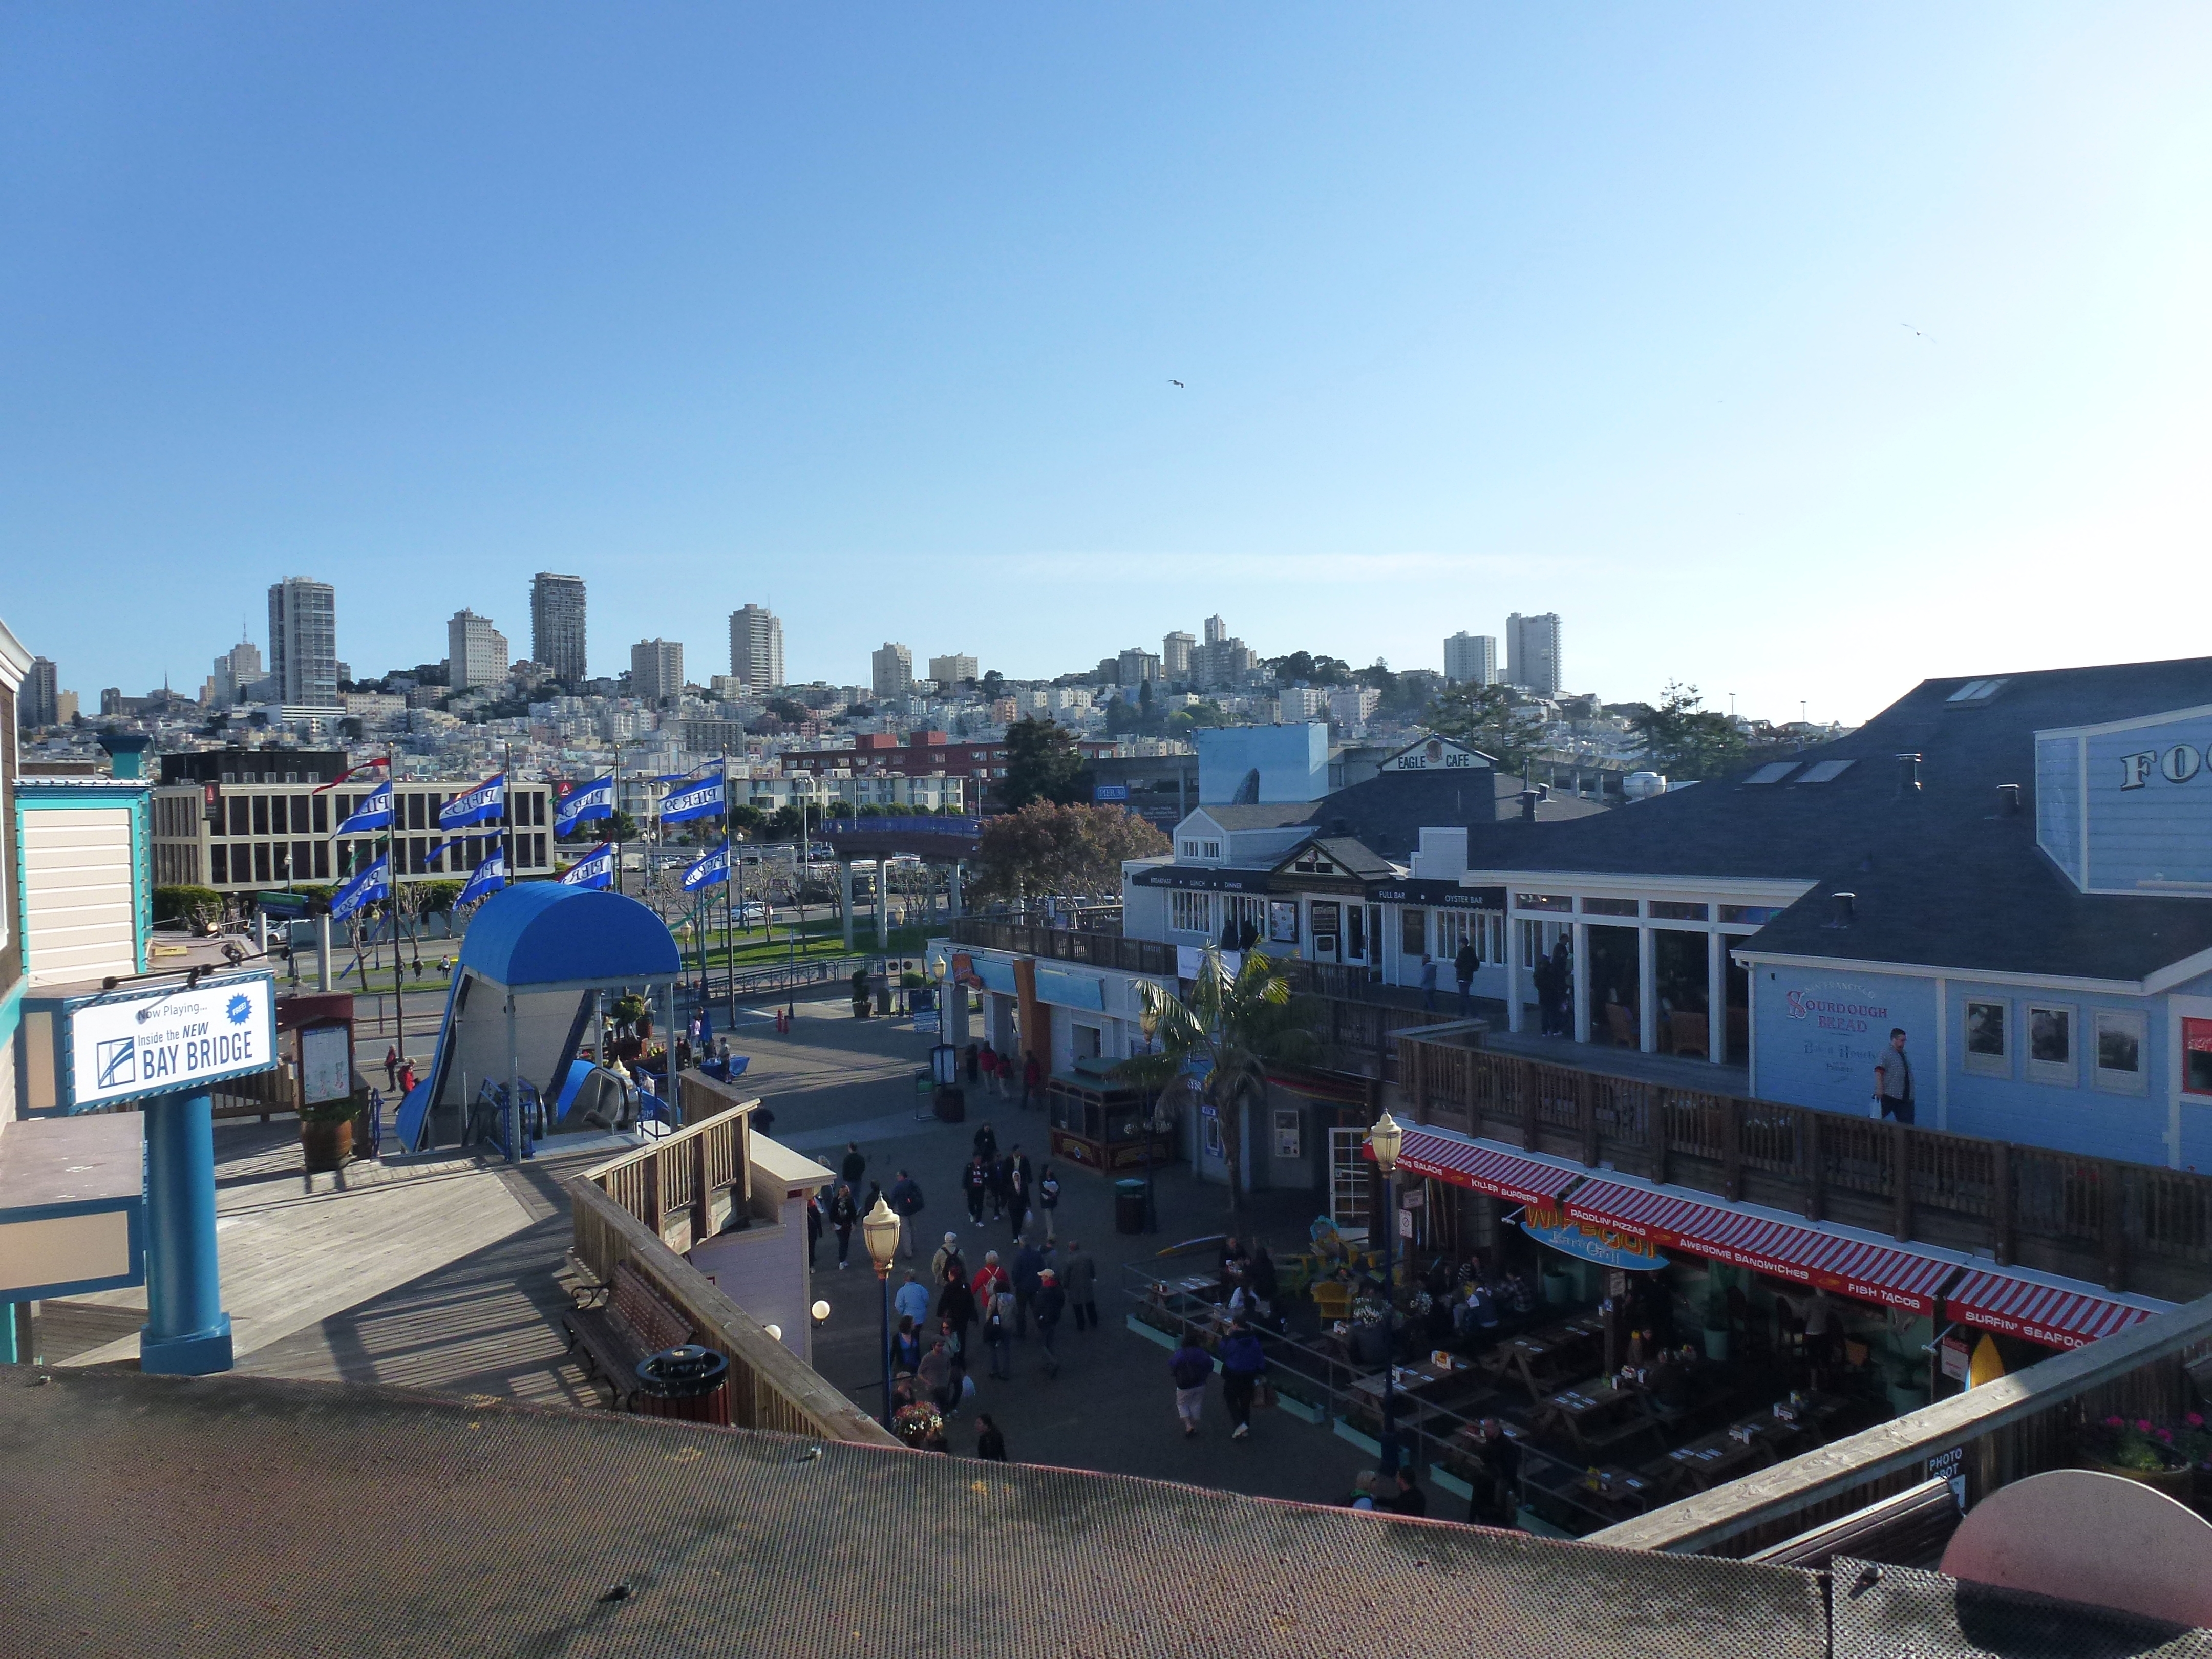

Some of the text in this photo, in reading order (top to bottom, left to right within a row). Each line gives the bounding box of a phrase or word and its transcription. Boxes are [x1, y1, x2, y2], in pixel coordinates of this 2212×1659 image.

[1398, 753, 1469, 769] EAGLE CAFE
[2120, 743, 2212, 792] FO
[1099, 789, 1115, 797] PIER
[1151, 877, 1172, 885] BREAKFAST
[1379, 890, 1392, 899] FULL
[1445, 895, 1482, 904] OYSTER BAR
[137, 1008, 161, 1021] Now
[232, 1001, 247, 1016] FREE!
[1786, 990, 1888, 1019] SOURDOUGH
[138, 1022, 209, 1047] Inside the NEW
[1818, 1015, 1868, 1033] BREAD
[143, 1030, 253, 1080] BAY BRIDGE
[1413, 1160, 1443, 1176] SALADS
[1471, 1178, 1538, 1204] KILLER BURGERS
[1571, 1209, 1646, 1236] PADDLIN' PIZZAS
[1680, 1238, 1809, 1280] AWESOME SANDWICHES
[1848, 1283, 1920, 1309] FISH TACOS
[1965, 1311, 2084, 1348] SURFIN' SEAFOO
[1929, 1447, 1963, 1471] PHOTO
